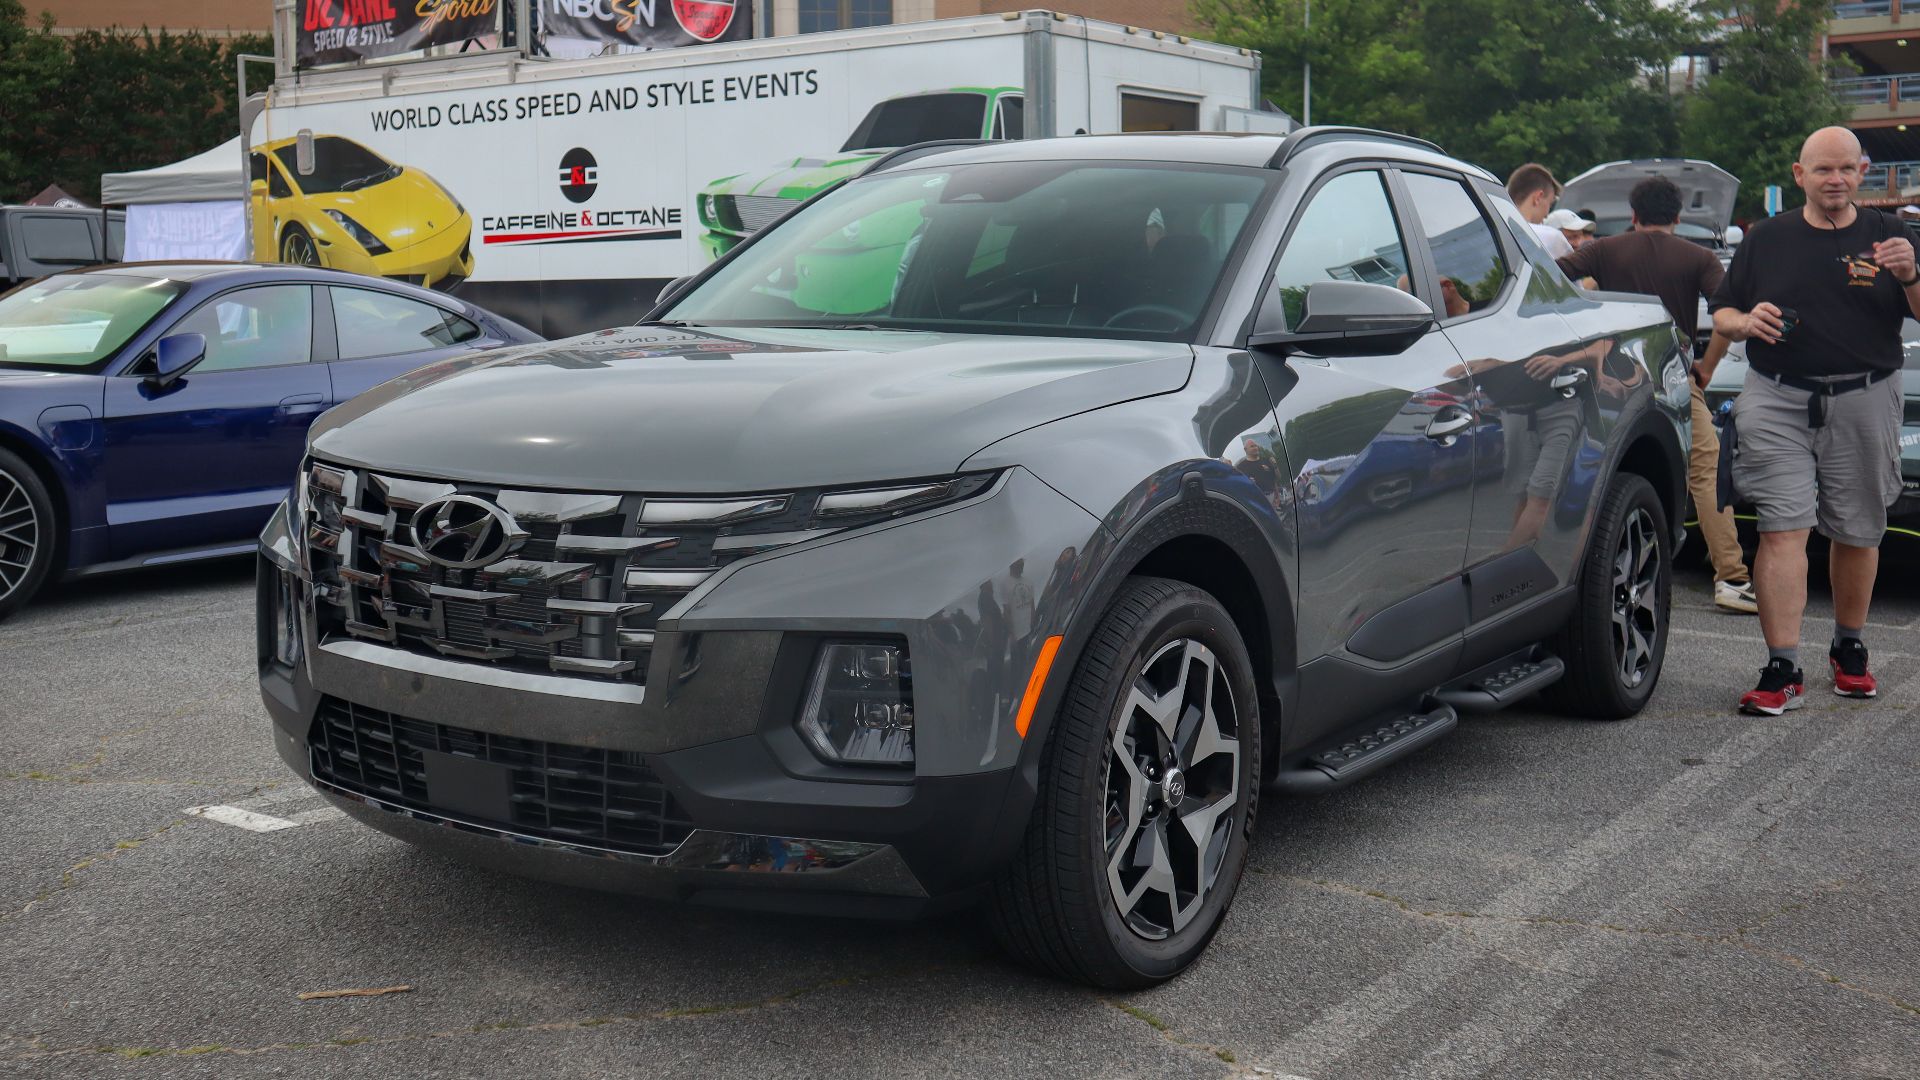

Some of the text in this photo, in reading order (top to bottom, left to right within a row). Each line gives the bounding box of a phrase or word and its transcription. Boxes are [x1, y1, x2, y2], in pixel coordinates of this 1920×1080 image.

[313, 22, 395, 53] SPEED & STYLE
[371, 69, 818, 132] WORLD CLASS SPEED AND STYLE EVENTS
[482, 206, 681, 232] CAFFEINE & OCTANE
